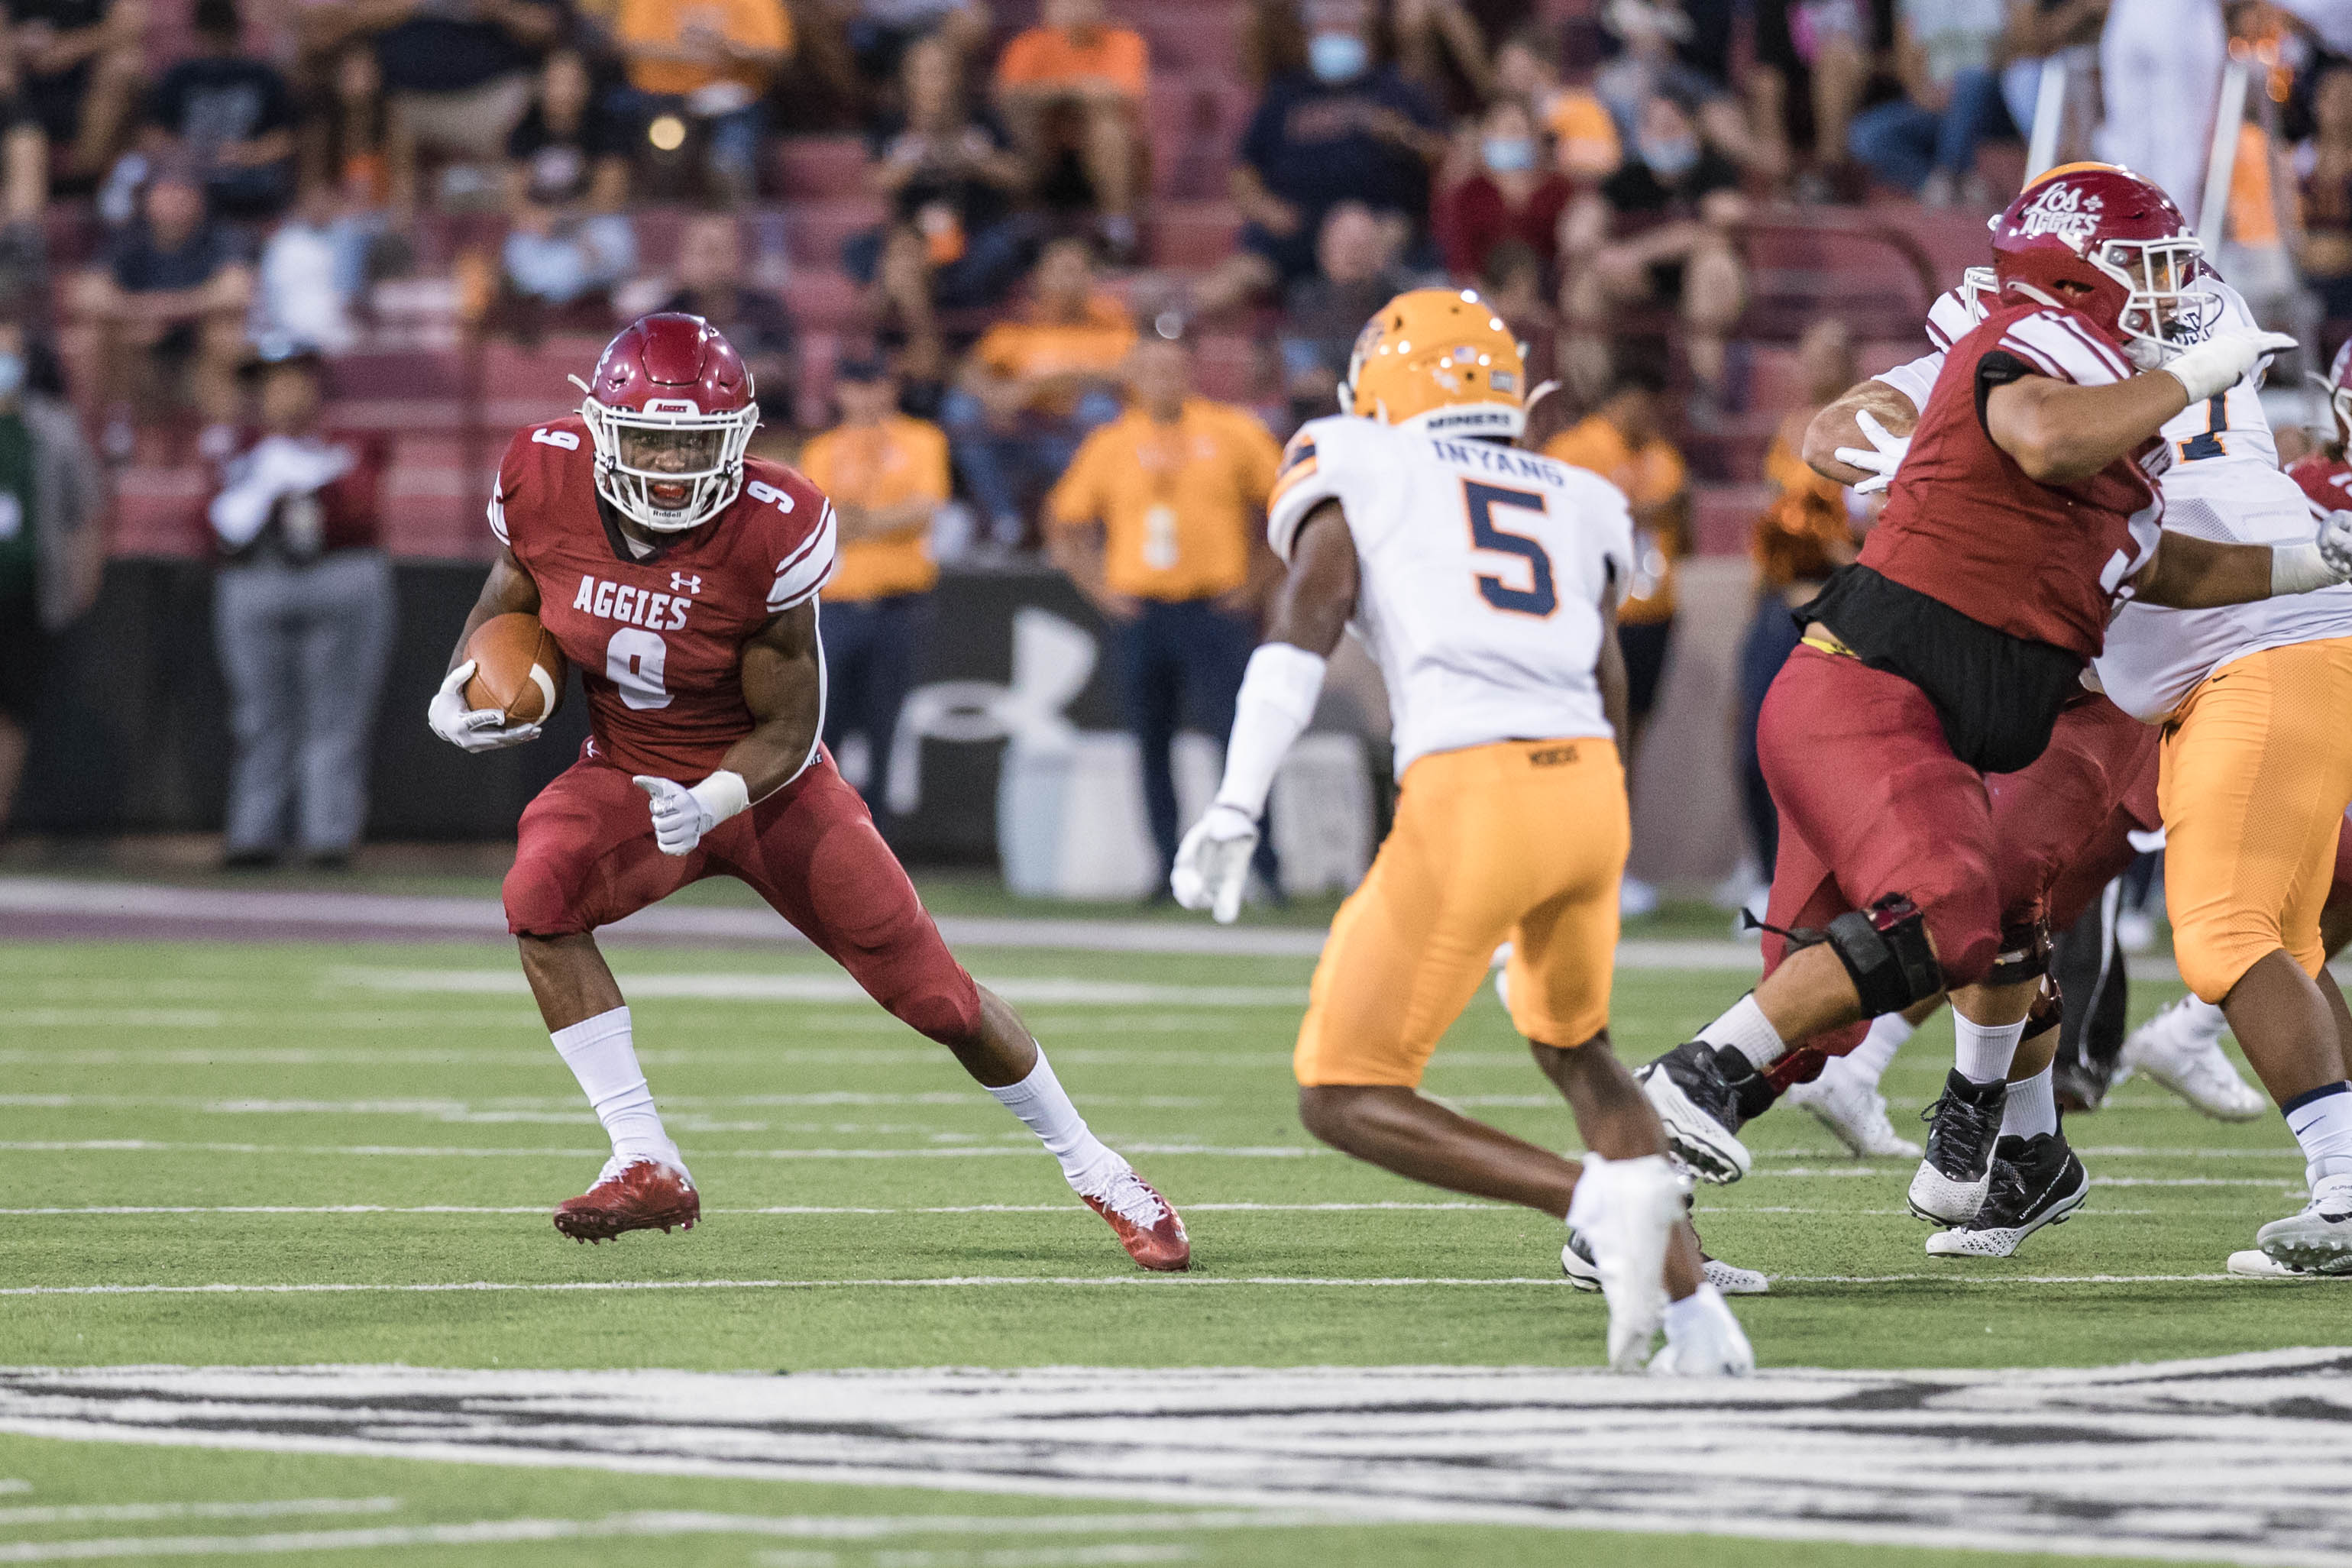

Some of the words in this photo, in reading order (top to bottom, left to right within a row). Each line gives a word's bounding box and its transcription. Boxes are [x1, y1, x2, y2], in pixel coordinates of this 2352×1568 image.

[531, 428, 581, 451] 9
[1427, 413, 1511, 429] MINERS
[1431, 439, 1564, 488] INYANG
[652, 509, 682, 519] Riddell
[746, 480, 795, 514] 9
[1460, 476, 1560, 622] 5
[573, 575, 692, 631] AGGIES
[606, 626, 675, 710] 9
